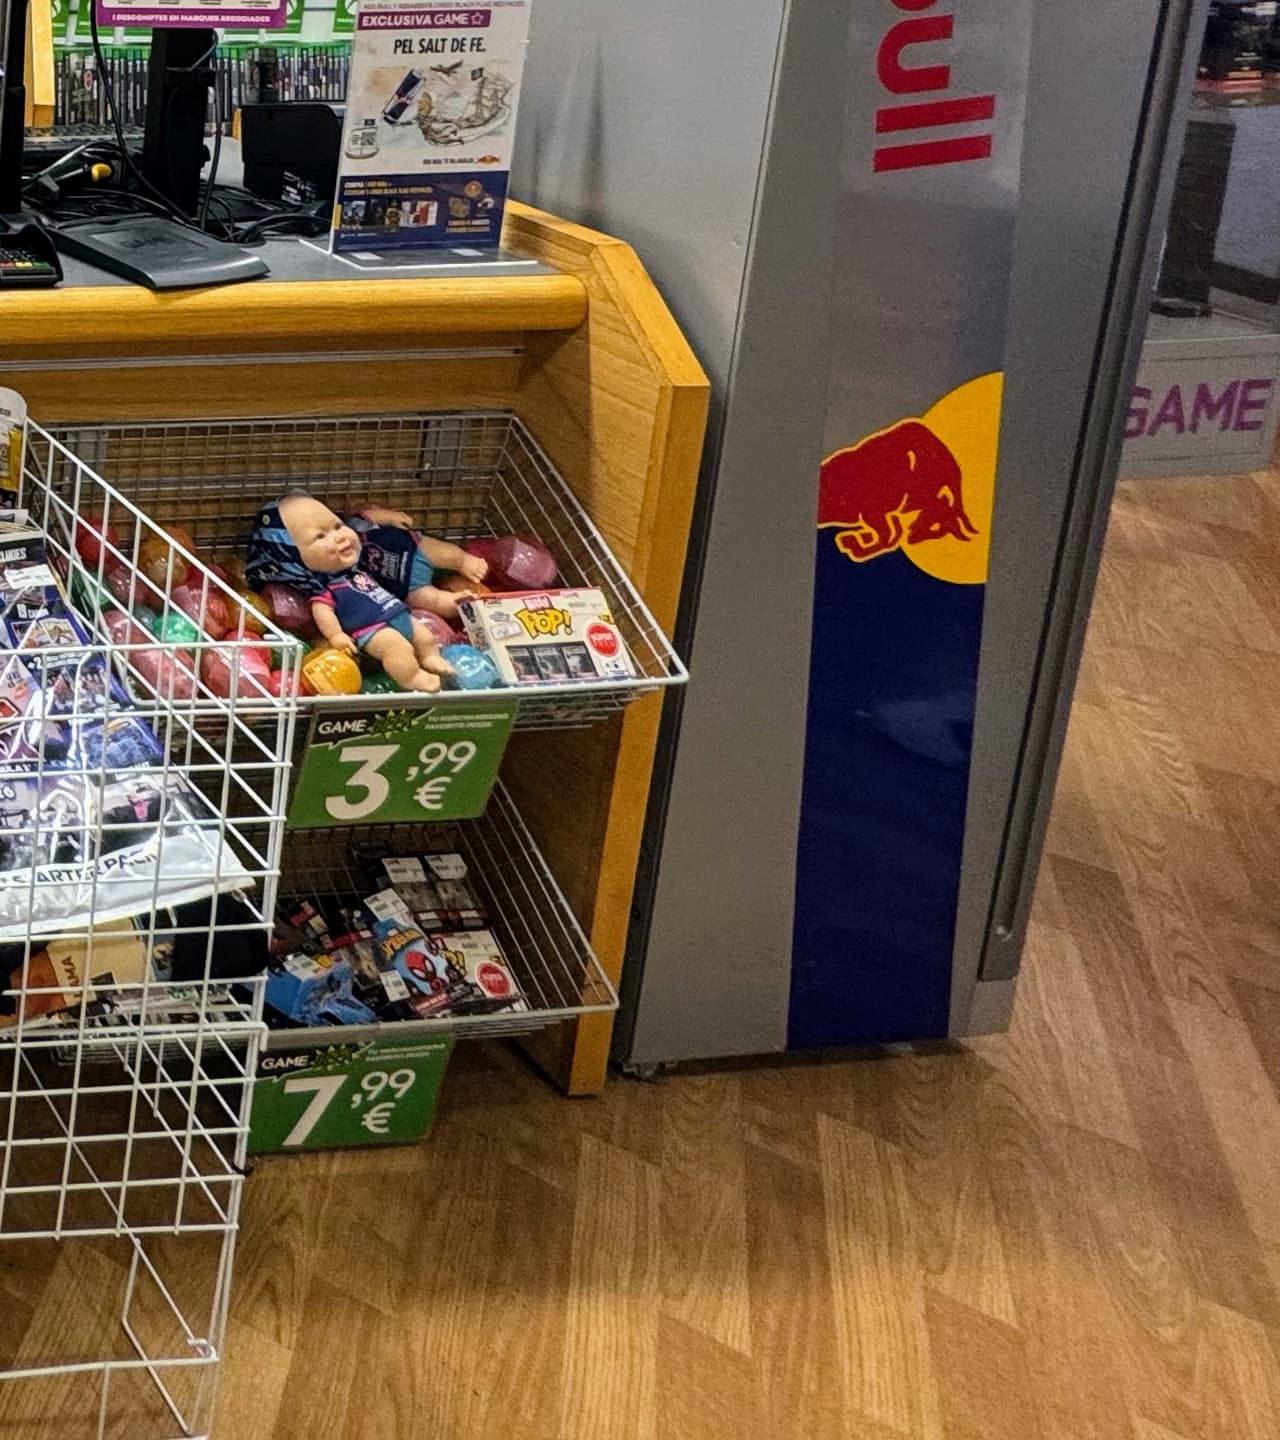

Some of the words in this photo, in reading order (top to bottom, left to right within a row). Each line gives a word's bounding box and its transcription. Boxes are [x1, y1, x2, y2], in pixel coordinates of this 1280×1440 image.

[361, 14, 432, 27] EXCLUSIVA
[433, 13, 469, 26] GAME
[393, 38, 415, 54] PEL
[418, 37, 449, 54] SALT
[450, 37, 466, 53] DE
[469, 37, 487, 53] FE.
[1125, 378, 1277, 440] GAME
[514, 607, 574, 640] POP!
[318, 719, 367, 735] GAME
[261, 1054, 310, 1070] GAME
